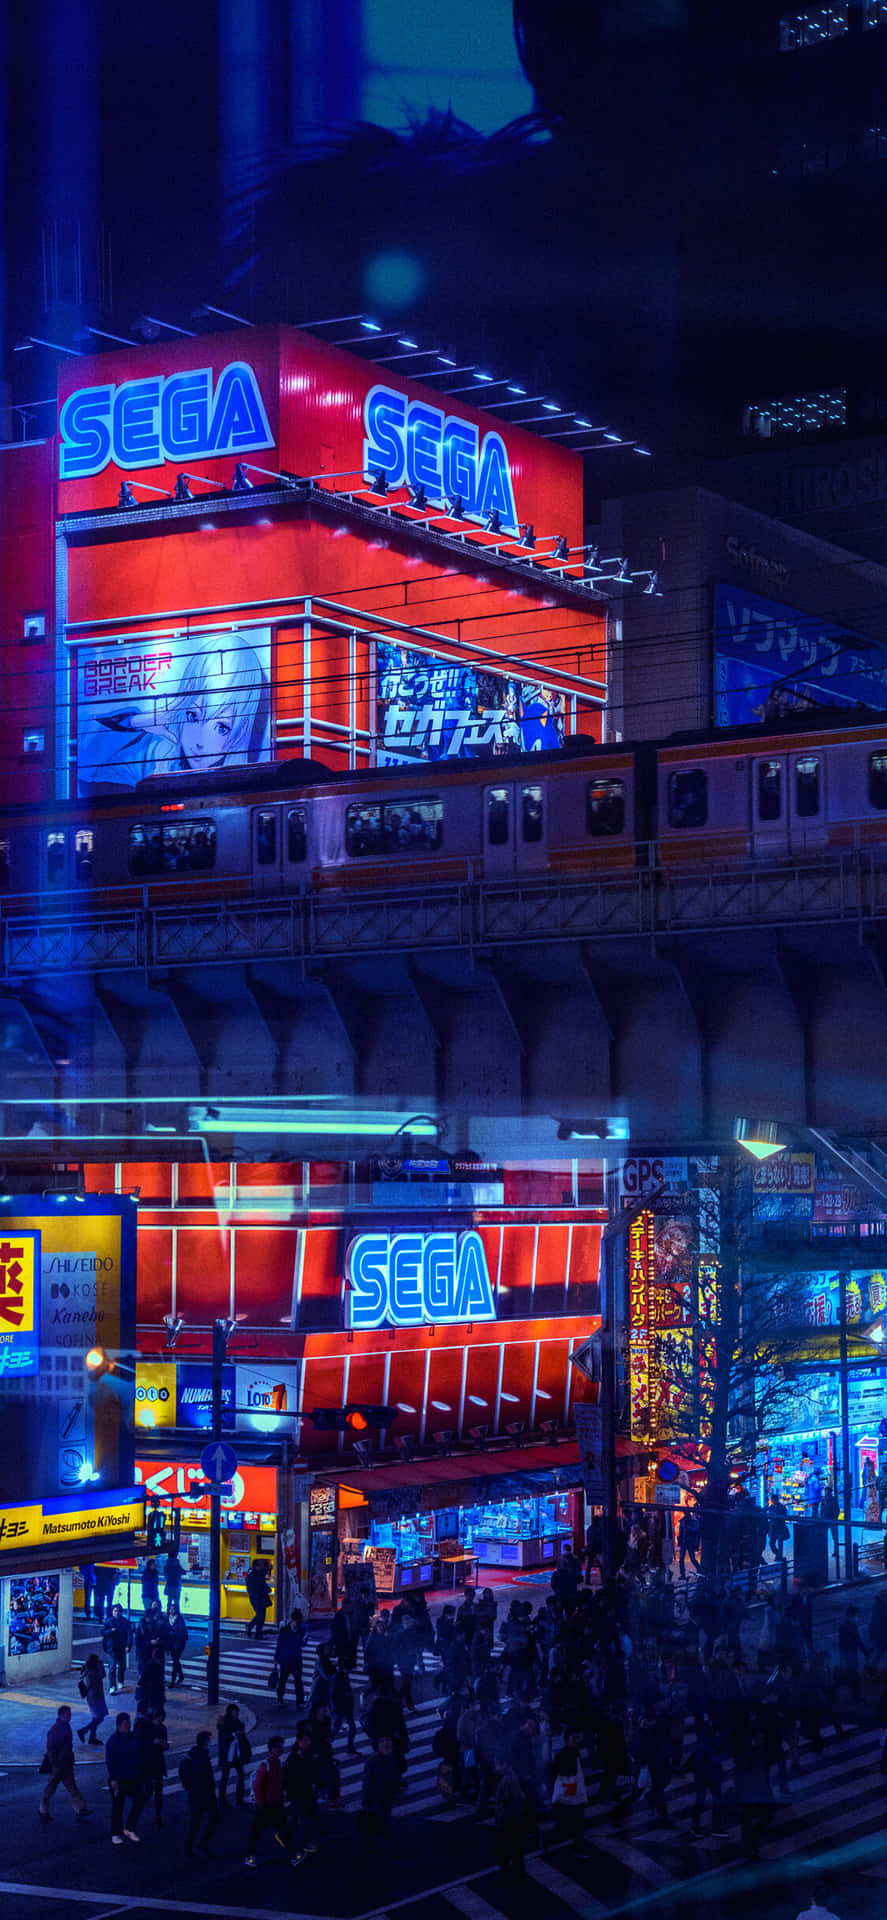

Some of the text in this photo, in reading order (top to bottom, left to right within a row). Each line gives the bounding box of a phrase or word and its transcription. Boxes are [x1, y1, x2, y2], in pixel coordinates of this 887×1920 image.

[60, 361, 275, 480] SEGA
[363, 384, 520, 537] SEGA
[84, 652, 172, 678] BORDER
[84, 672, 156, 696] BREAK
[44, 1257, 114, 1273] SHISEIDO
[345, 1231, 496, 1329] SEGA
[52, 1306, 105, 1324] Kanebo
[630, 1329, 648, 1339] 2F
[273, 1383, 286, 1412] 7
[42, 1512, 131, 1536] Matsumoto KiYoshi
